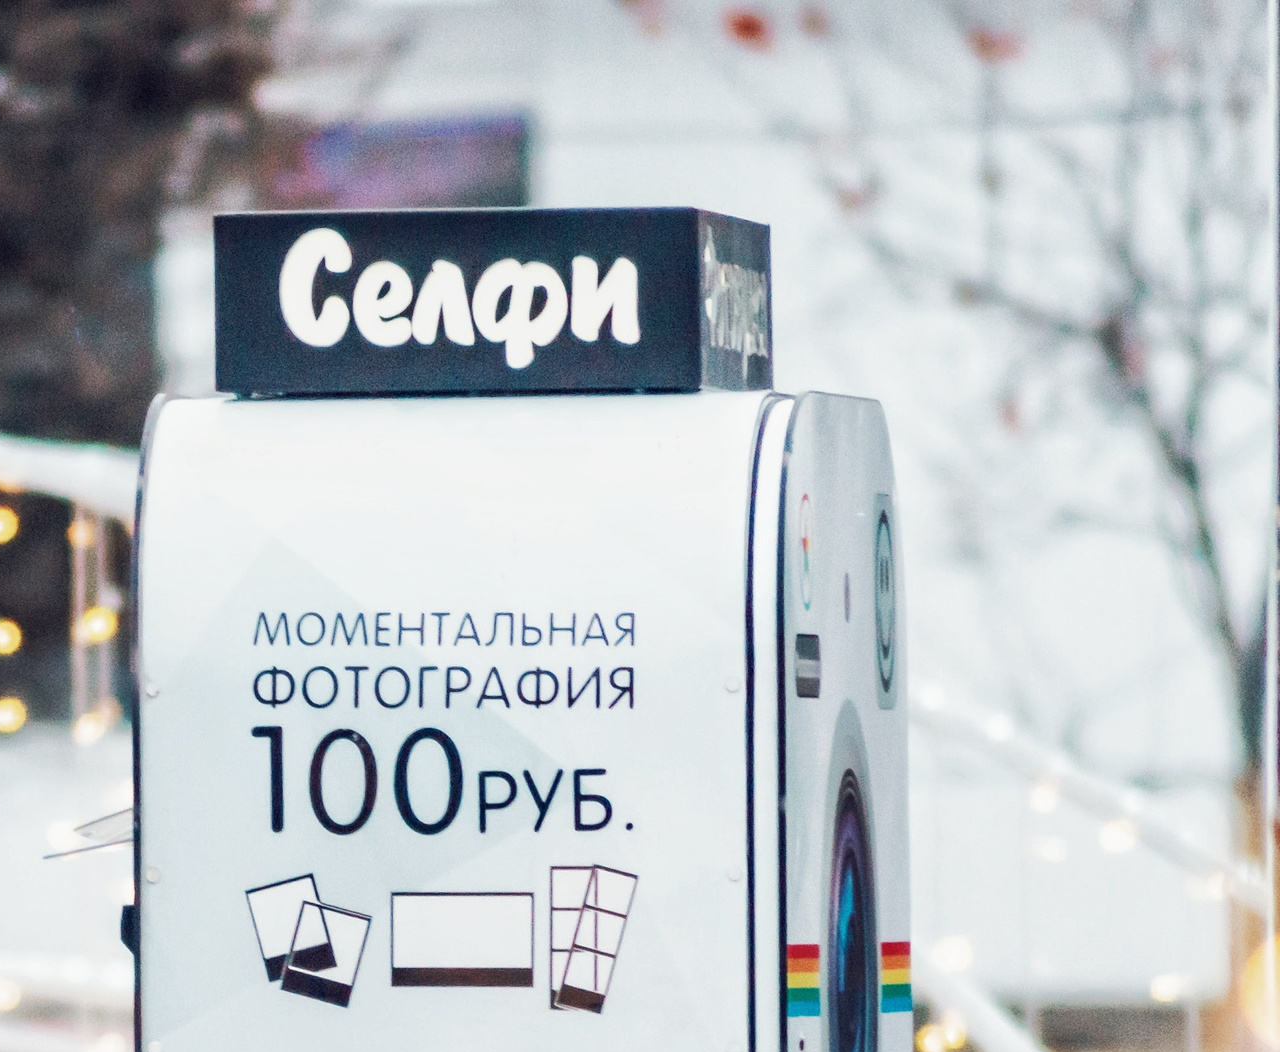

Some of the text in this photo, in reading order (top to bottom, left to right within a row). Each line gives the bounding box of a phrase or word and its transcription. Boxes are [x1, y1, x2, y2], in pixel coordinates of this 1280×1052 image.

[278, 227, 642, 370] Селфи
[253, 611, 636, 648] МОМЕНТАЛЬНАЯ
[252, 665, 636, 711] ФОТОГРАФИЯ
